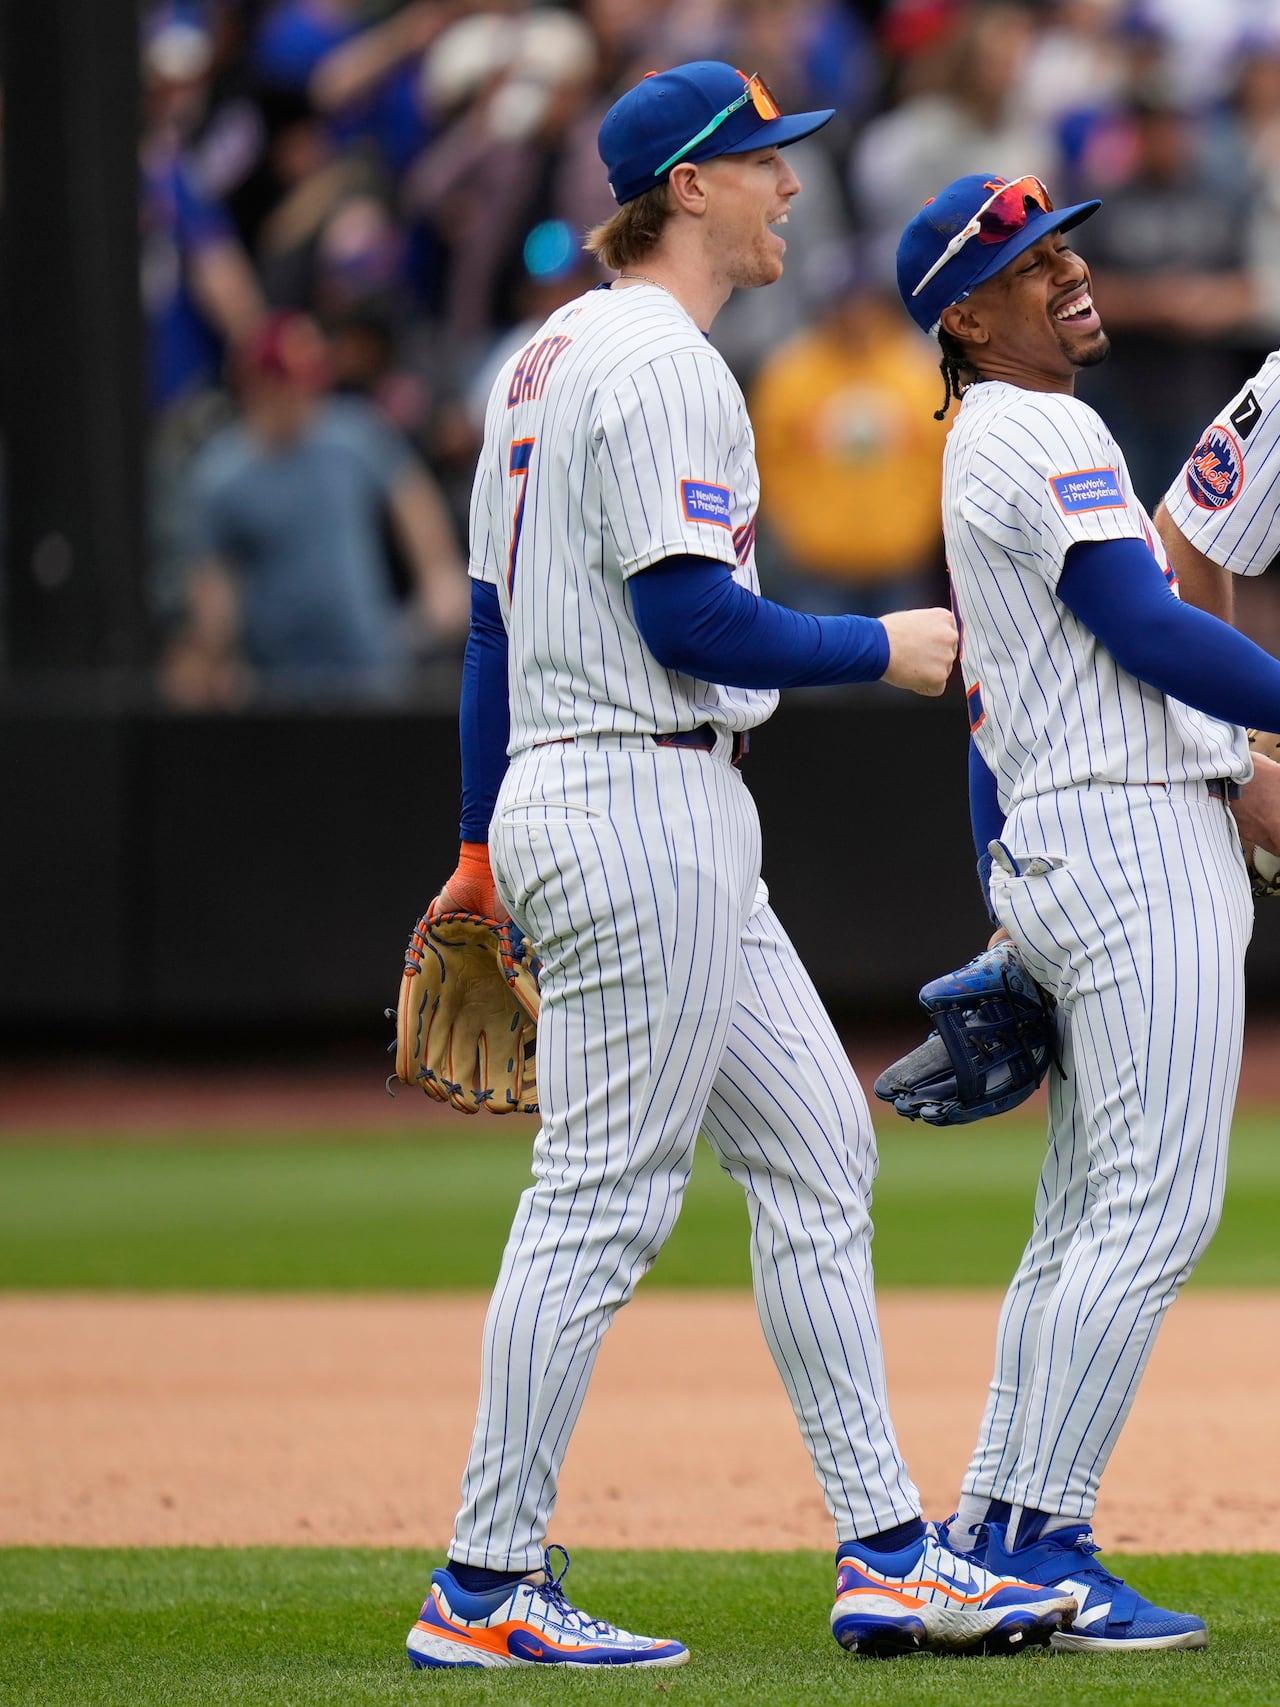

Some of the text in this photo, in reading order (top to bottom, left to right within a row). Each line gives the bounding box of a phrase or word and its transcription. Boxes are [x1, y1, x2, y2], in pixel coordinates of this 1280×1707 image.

[507, 335, 574, 411] BATY
[1072, 487, 1118, 501] Presbyterian
[1194, 452, 1232, 494] Mets
[506, 437, 536, 612] 7
